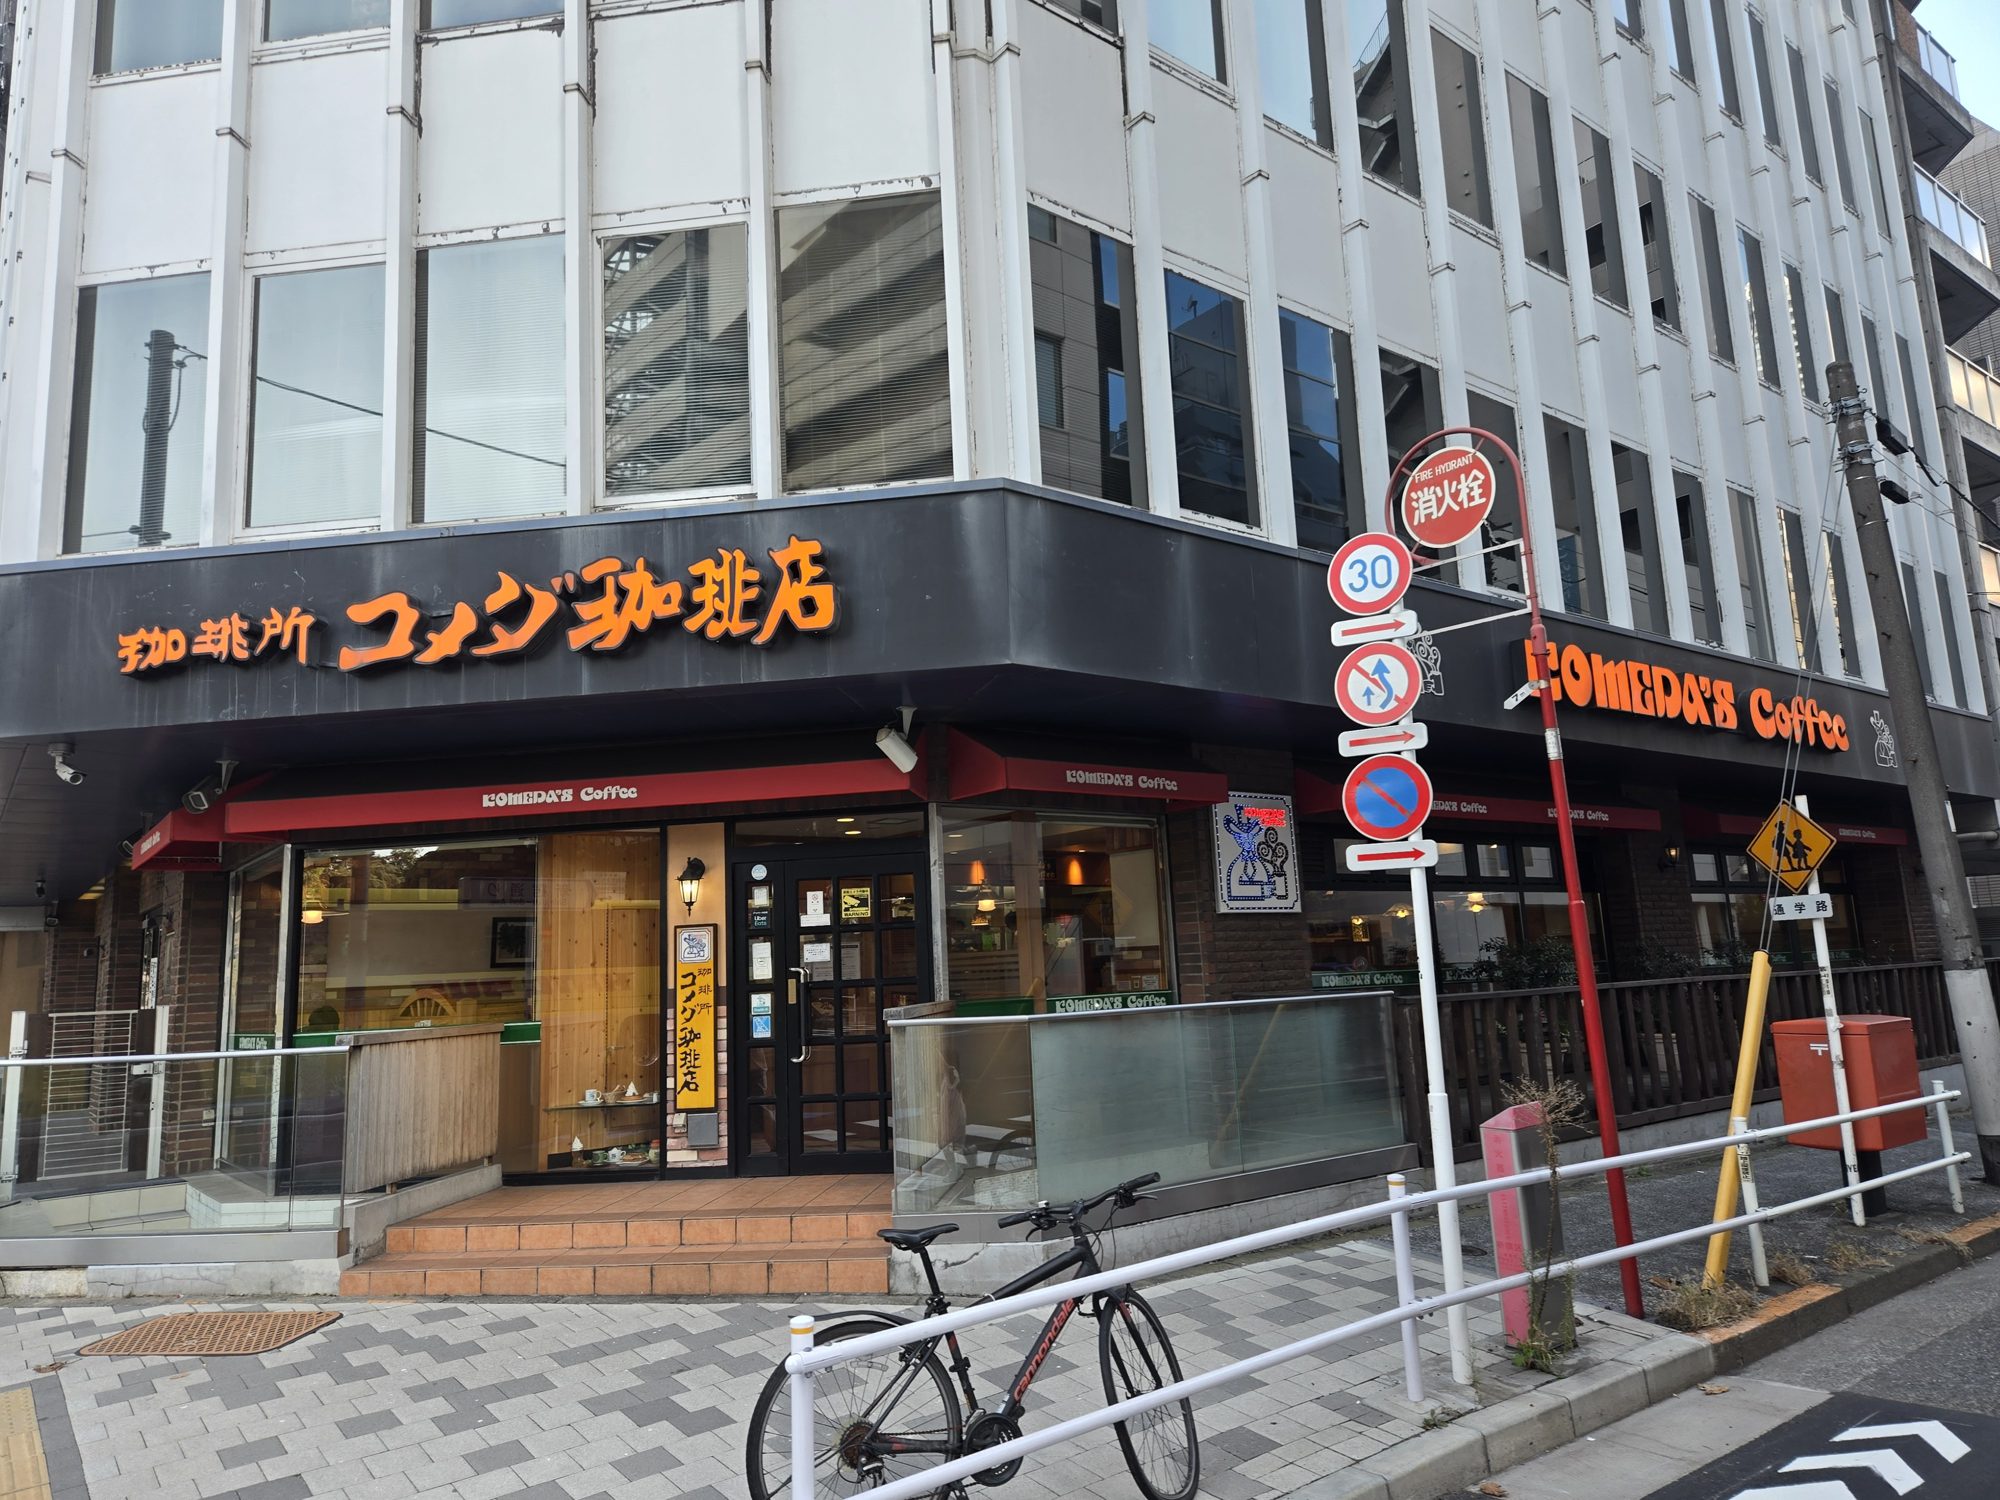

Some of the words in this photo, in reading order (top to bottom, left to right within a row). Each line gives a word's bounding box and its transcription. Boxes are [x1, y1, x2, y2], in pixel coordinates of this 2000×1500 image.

[1415, 468, 1434, 484] FIRE
[1435, 453, 1475, 475] HYDRANT
[1409, 469, 1487, 526] 消火栓
[1348, 554, 1393, 593] 30
[118, 606, 315, 674] 珈琲所
[338, 535, 836, 672] コメダ珈琲店
[1524, 639, 1738, 730] KOMEDA'S
[1750, 687, 1850, 752] Coffee
[482, 788, 573, 808] KOMEDA'S
[580, 785, 637, 801] Coffee
[1066, 770, 1133, 787] KOMEDA'S
[1138, 776, 1178, 791] Coffee
[1460, 802, 1487, 814] Coffee
[1774, 900, 1828, 916] 通学路
[697, 968, 713, 1016] 珈琲所
[1056, 996, 1123, 1013] KOMEDA'S
[1127, 994, 1167, 1008] Coffee
[677, 971, 702, 1095] コメダ珈琲店
[1013, 1297, 1075, 1401] cannondale
